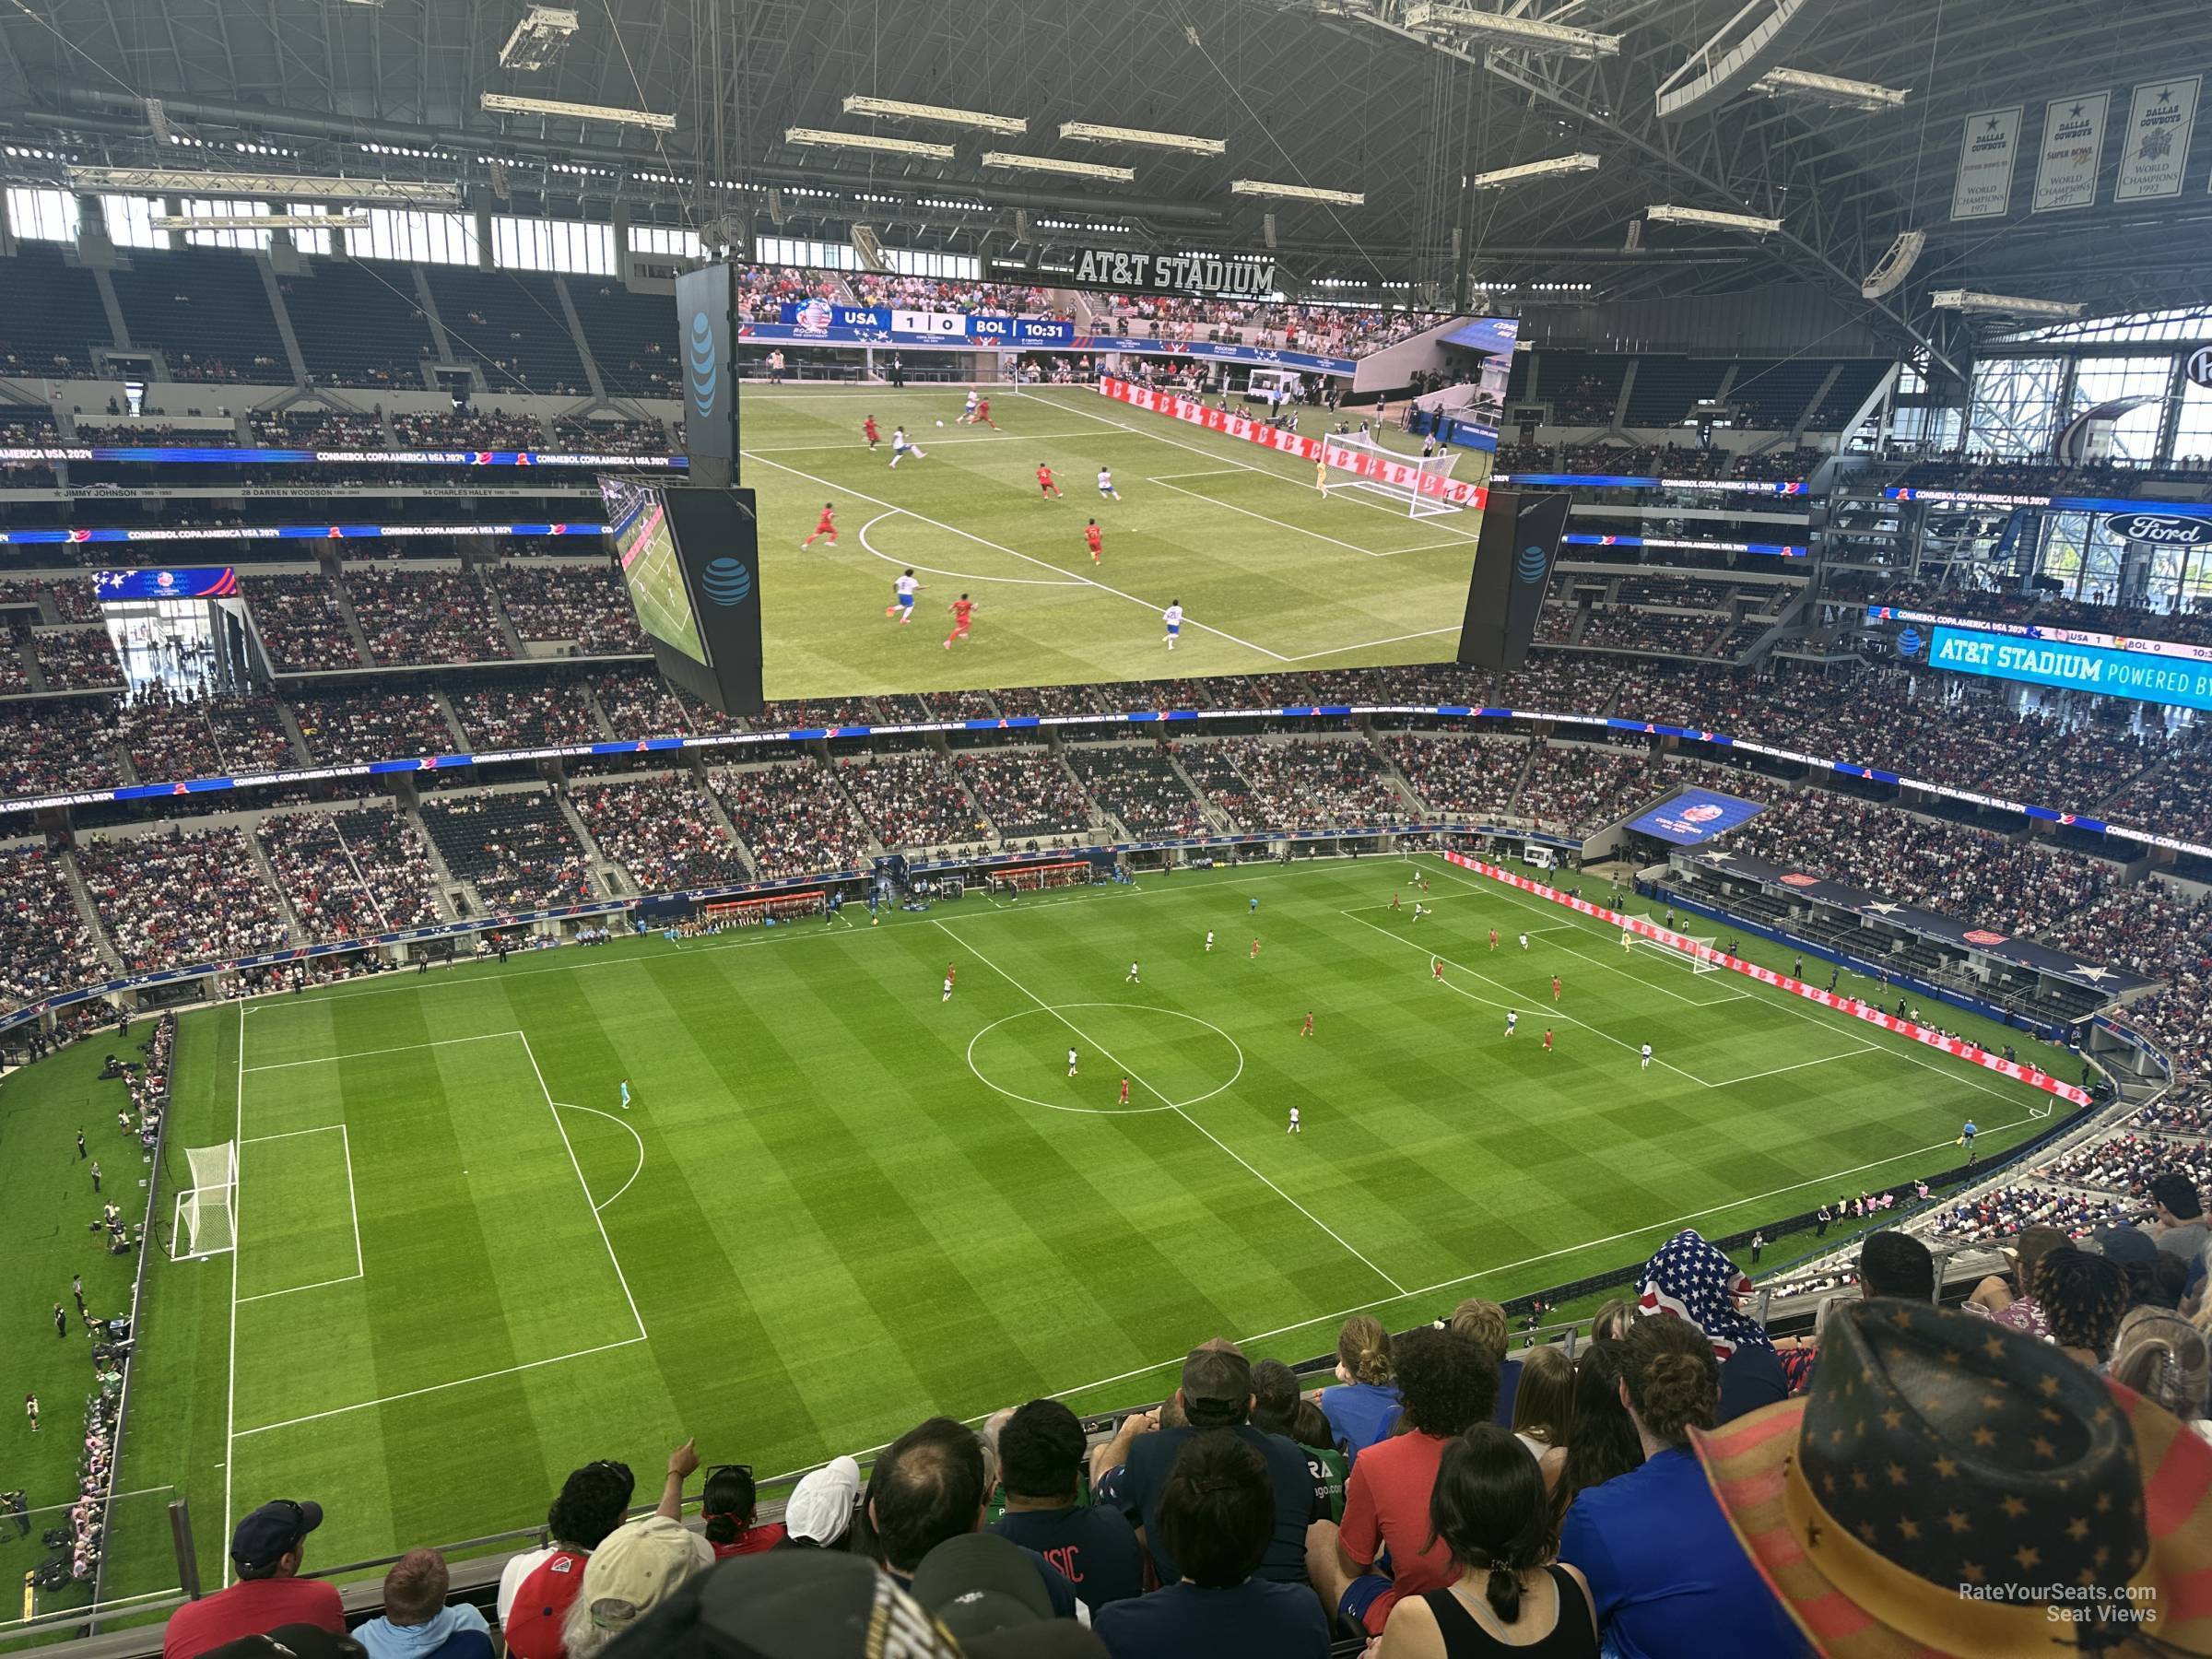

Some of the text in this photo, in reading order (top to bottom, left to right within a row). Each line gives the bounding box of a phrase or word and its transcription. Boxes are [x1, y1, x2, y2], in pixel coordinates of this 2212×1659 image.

[2146, 105, 2179, 117] DALLAS
[2059, 120, 2089, 131] DALLAS
[2140, 114, 2181, 126] COWBOYS
[1976, 133, 2005, 143] DALLAS
[2054, 128, 2092, 140] COWBOYS
[2136, 163, 2170, 173] WORLD
[2050, 175, 2083, 184] WORLD
[2123, 173, 2177, 184] CHAMPIONS
[1968, 185, 1996, 194] WORLD
[1076, 250, 1276, 295] AT&T STADIUM
[844, 312, 1063, 337] USA 1 0 BOL 10:31
[45, 450, 67, 459] USA
[68, 450, 93, 459] 2024
[317, 453, 465, 462] CONMEBOL COPA AMERICA USA 2024
[536, 455, 580, 464] CONMEBOL
[601, 456, 635, 465] AMERICA
[651, 457, 669, 465] 2024
[1661, 479, 1698, 488] CONMEBOL
[1714, 481, 1746, 489] AMERICA
[1915, 490, 2051, 506] CONMEBOL COPA AMERICA USA 2024
[128, 531, 178, 539] CONMEBOL
[202, 530, 241, 538] AMERICA
[2128, 516, 2201, 542] Ford
[1897, 610, 2028, 634] CONMEBOL COPA AMERICA USA 2024
[2070, 633, 2088, 642] USA
[2128, 641, 2147, 650] BOL
[2192, 649, 2212, 658] 10:3
[1939, 638, 1994, 665] AT&T
[1997, 645, 2103, 682] STADIUM
[2107, 664, 2190, 692] POWERED
[233, 776, 278, 786] CONMEBOL
[278, 774, 300, 782] COPA
[300, 769, 335, 780] AMERICA
[336, 768, 351, 776] USA
[1899, 778, 1937, 793] CONMEBOL
[1937, 786, 1957, 797] COPA
[1956, 791, 1990, 805] AMERICA
[1991, 798, 2006, 809] USA
[6, 803, 33, 811] COPA
[33, 797, 74, 809] AMERICA
[74, 795, 90, 804] USA
[92, 792, 115, 802] 2024
[2106, 825, 2155, 843] CONMEBOL
[2155, 837, 2181, 850] COPA
[1308, 1460, 1335, 1478] RA
